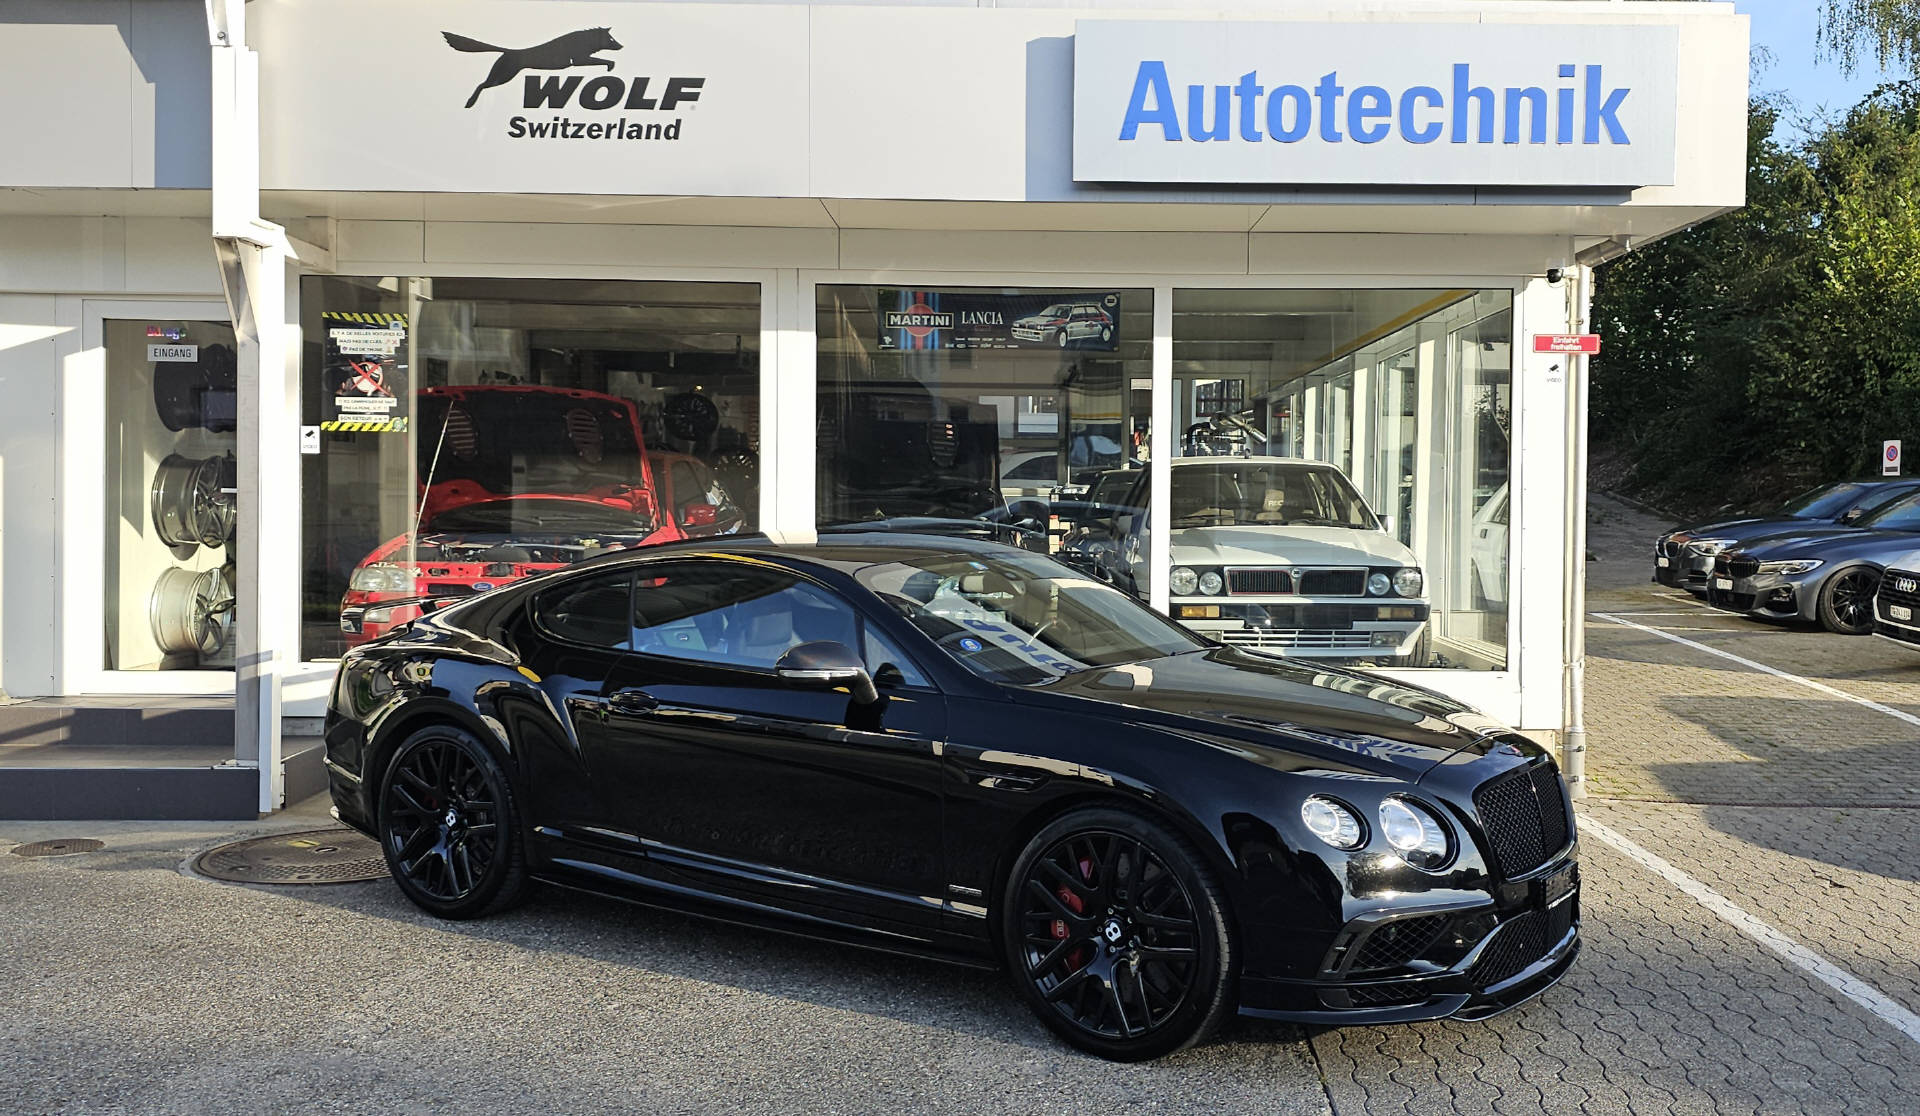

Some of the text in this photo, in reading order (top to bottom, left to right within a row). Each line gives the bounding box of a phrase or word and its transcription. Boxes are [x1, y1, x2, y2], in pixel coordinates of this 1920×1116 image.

[523, 75, 706, 110] WOLF
[1118, 60, 1631, 145] Autotechnik
[507, 116, 682, 140] Switzerland
[890, 311, 1004, 326] MARTINI LANCIA
[153, 348, 192, 358] EINGANG
